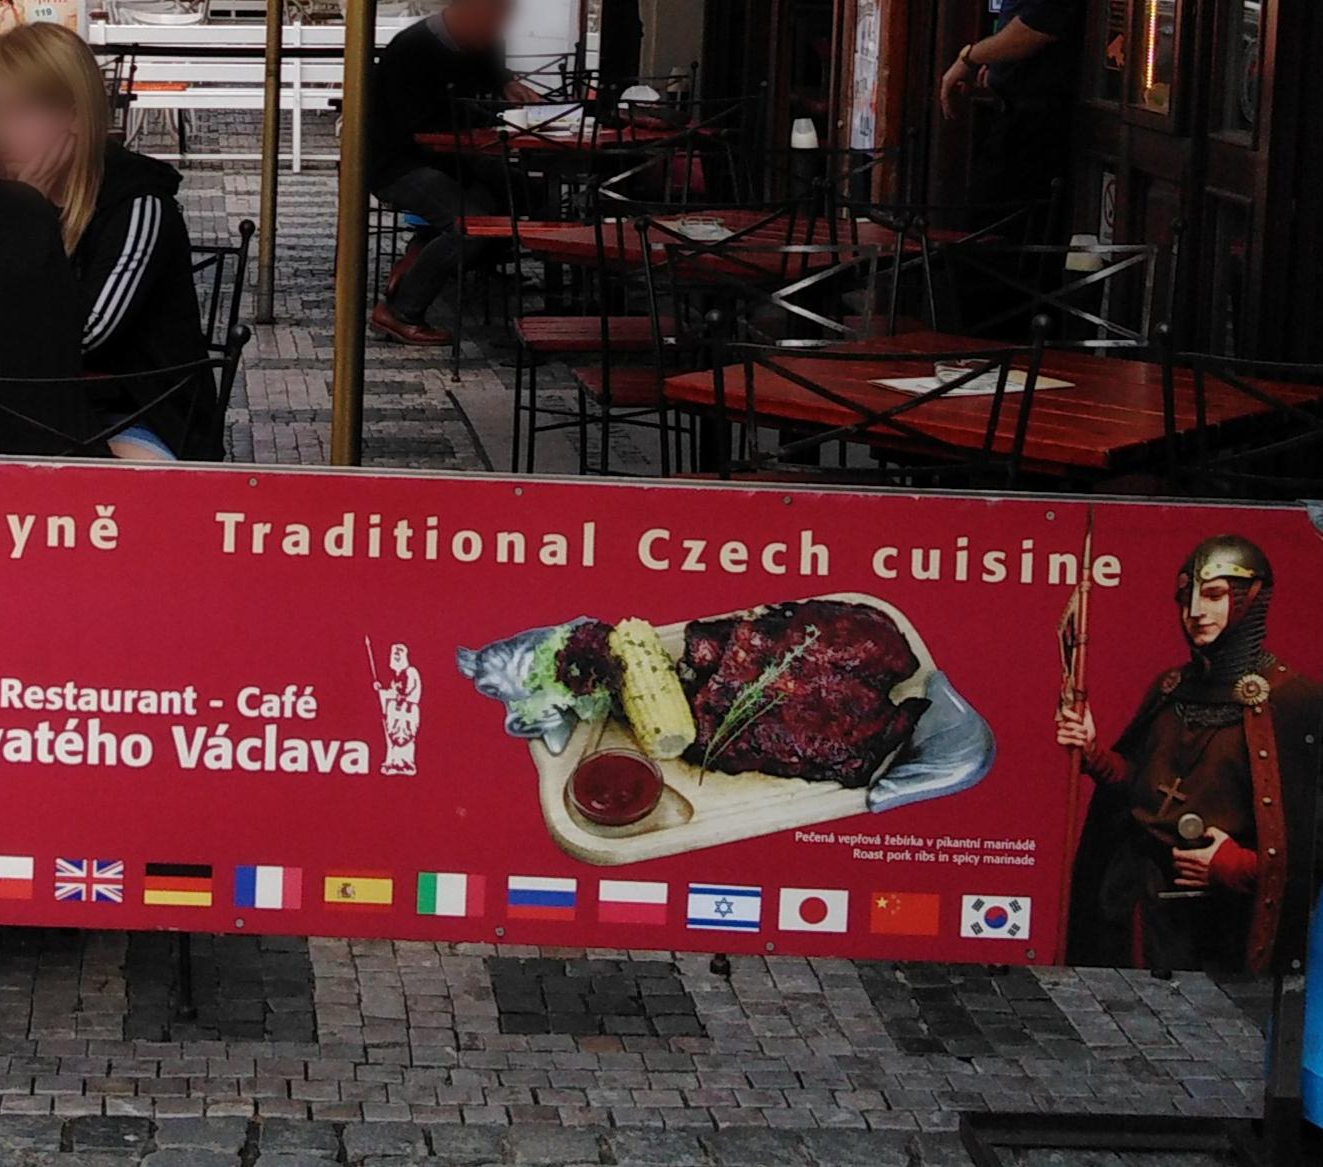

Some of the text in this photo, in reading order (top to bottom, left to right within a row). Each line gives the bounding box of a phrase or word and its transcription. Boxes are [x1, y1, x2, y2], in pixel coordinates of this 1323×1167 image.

[34, 8, 53, 17] 119
[215, 512, 1123, 587] Traditional Czech cuisine
[0, 678, 198, 716] Restaurant
[237, 685, 318, 719] Café
[171, 723, 371, 775] Václava
[795, 831, 835, 843] Pečená
[936, 836, 981, 849] pikantní
[853, 848, 1035, 866] Roast pork ribs in spicy marinade
